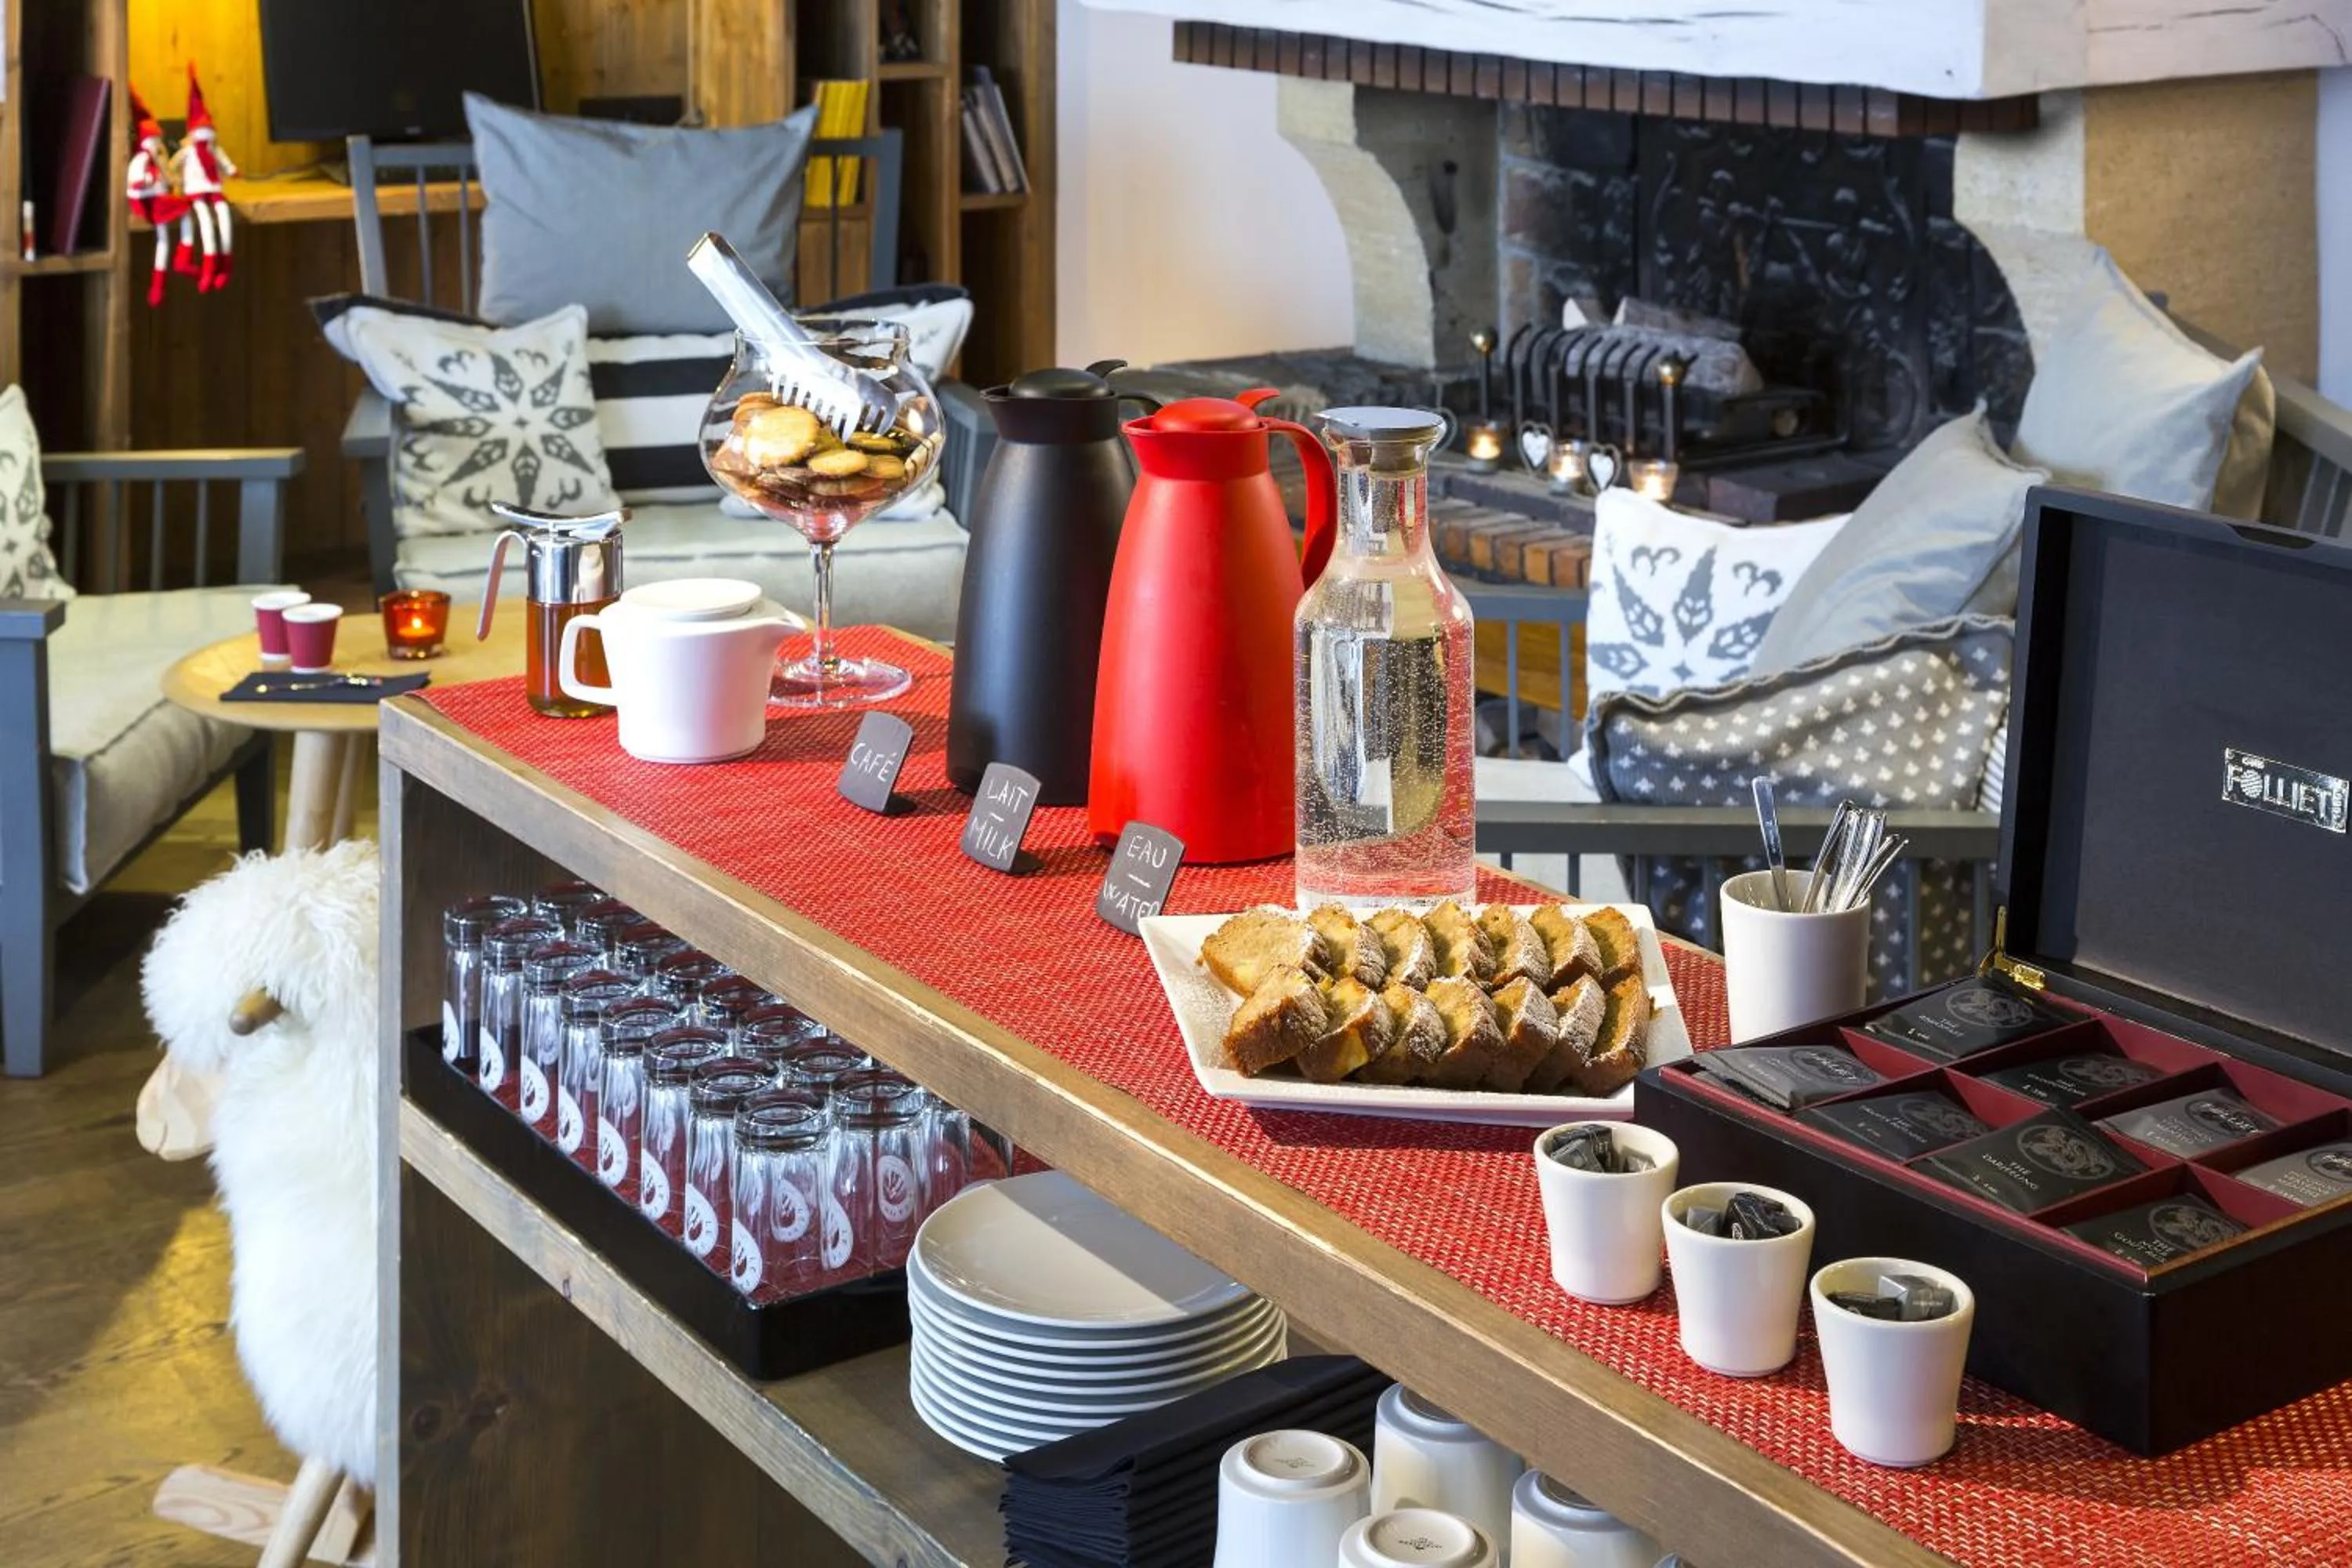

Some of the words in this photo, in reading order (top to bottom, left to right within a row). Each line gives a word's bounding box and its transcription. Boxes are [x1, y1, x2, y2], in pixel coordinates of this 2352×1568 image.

[851, 742, 897, 782] CAFÉ
[986, 777, 1029, 814] LAIT
[967, 815, 1014, 860] MILK
[1127, 835, 1167, 869] EAU
